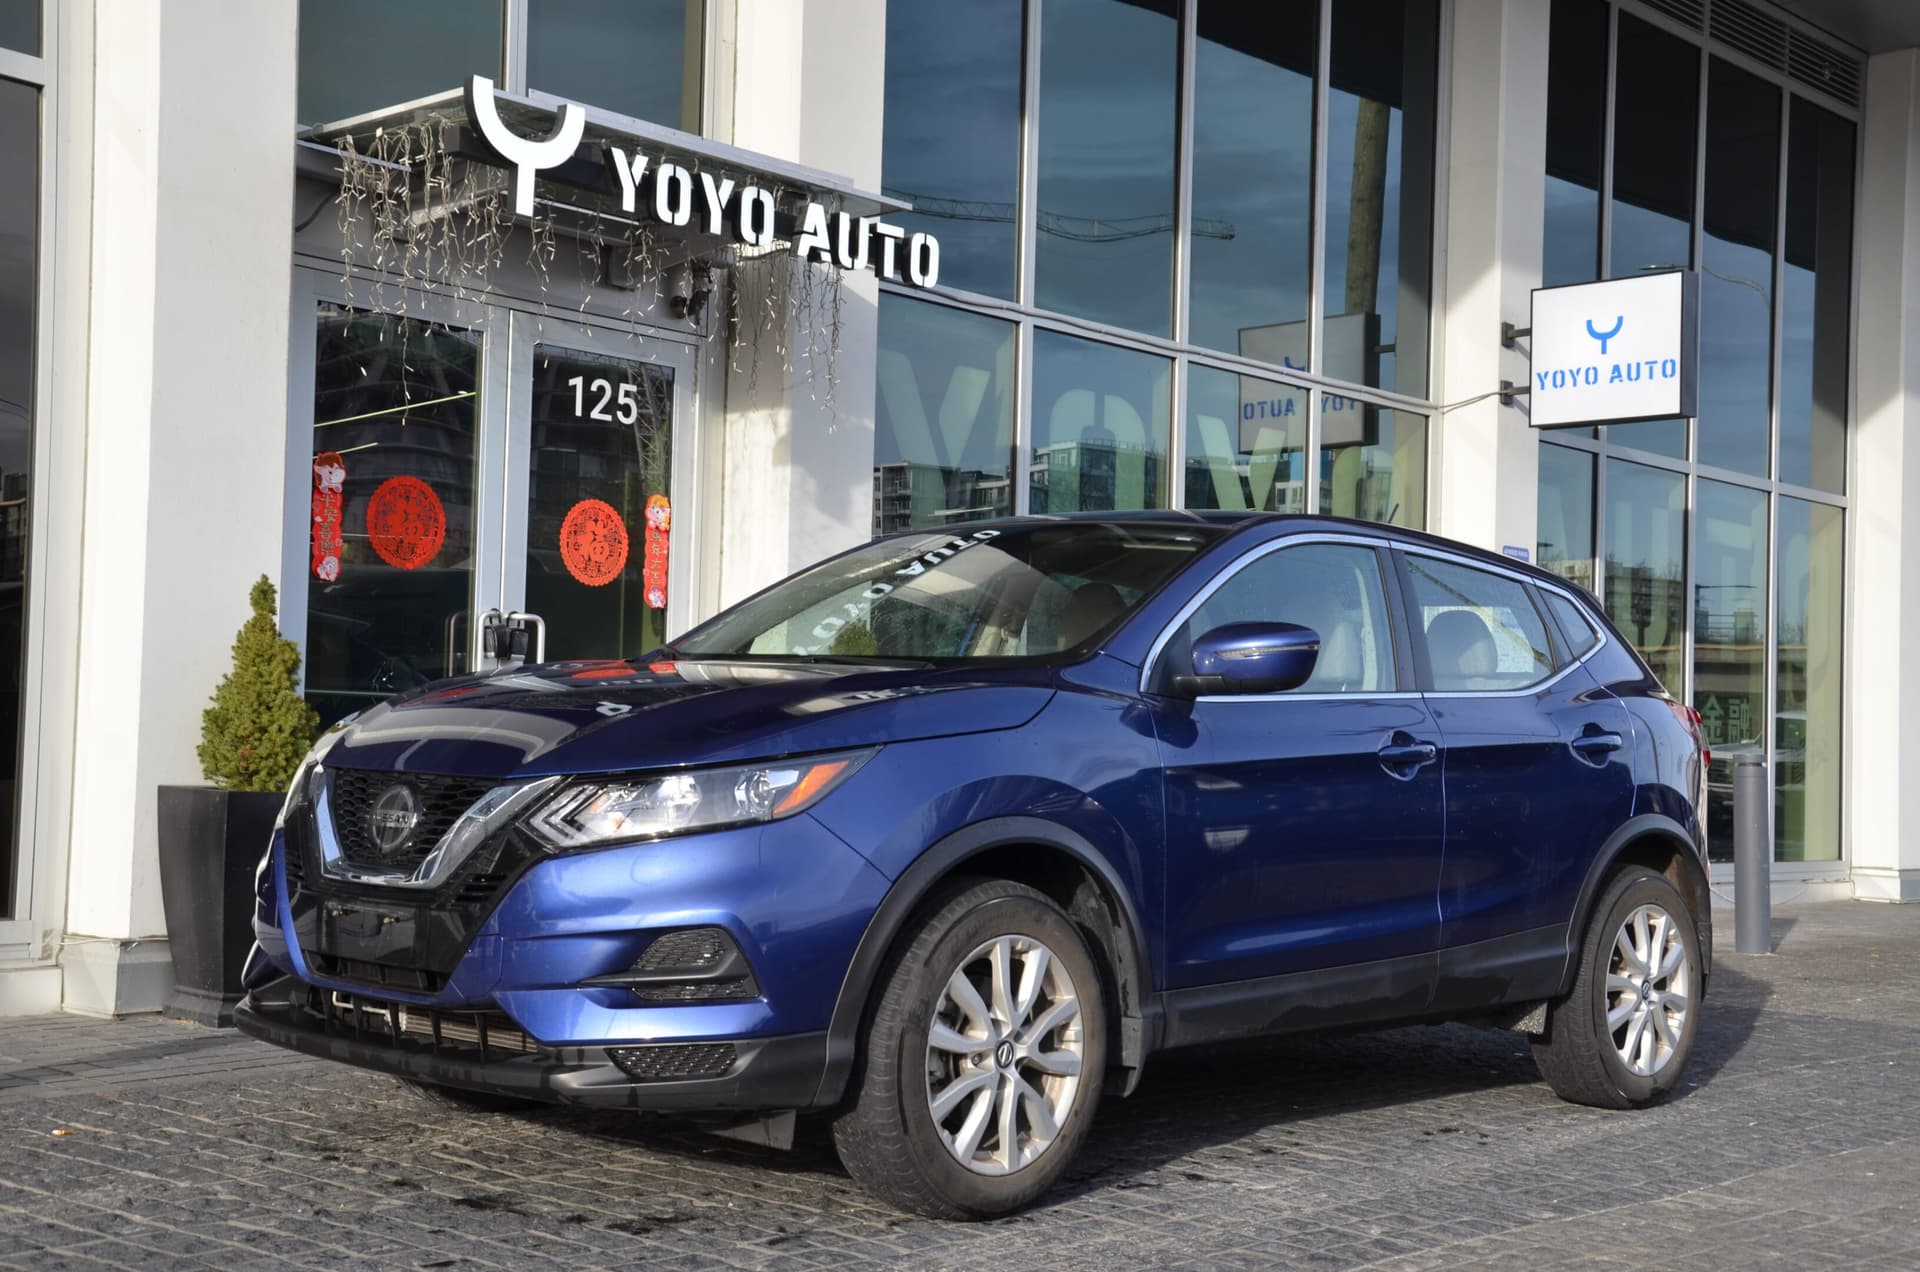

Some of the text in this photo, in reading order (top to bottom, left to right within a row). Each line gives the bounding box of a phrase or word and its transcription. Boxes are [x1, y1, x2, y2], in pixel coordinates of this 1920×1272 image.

[609, 146, 940, 288] YOYO AUTO
[568, 375, 637, 425] 125
[1536, 358, 1677, 391] YOYO AUTO
[1702, 693, 1752, 746] 金融
